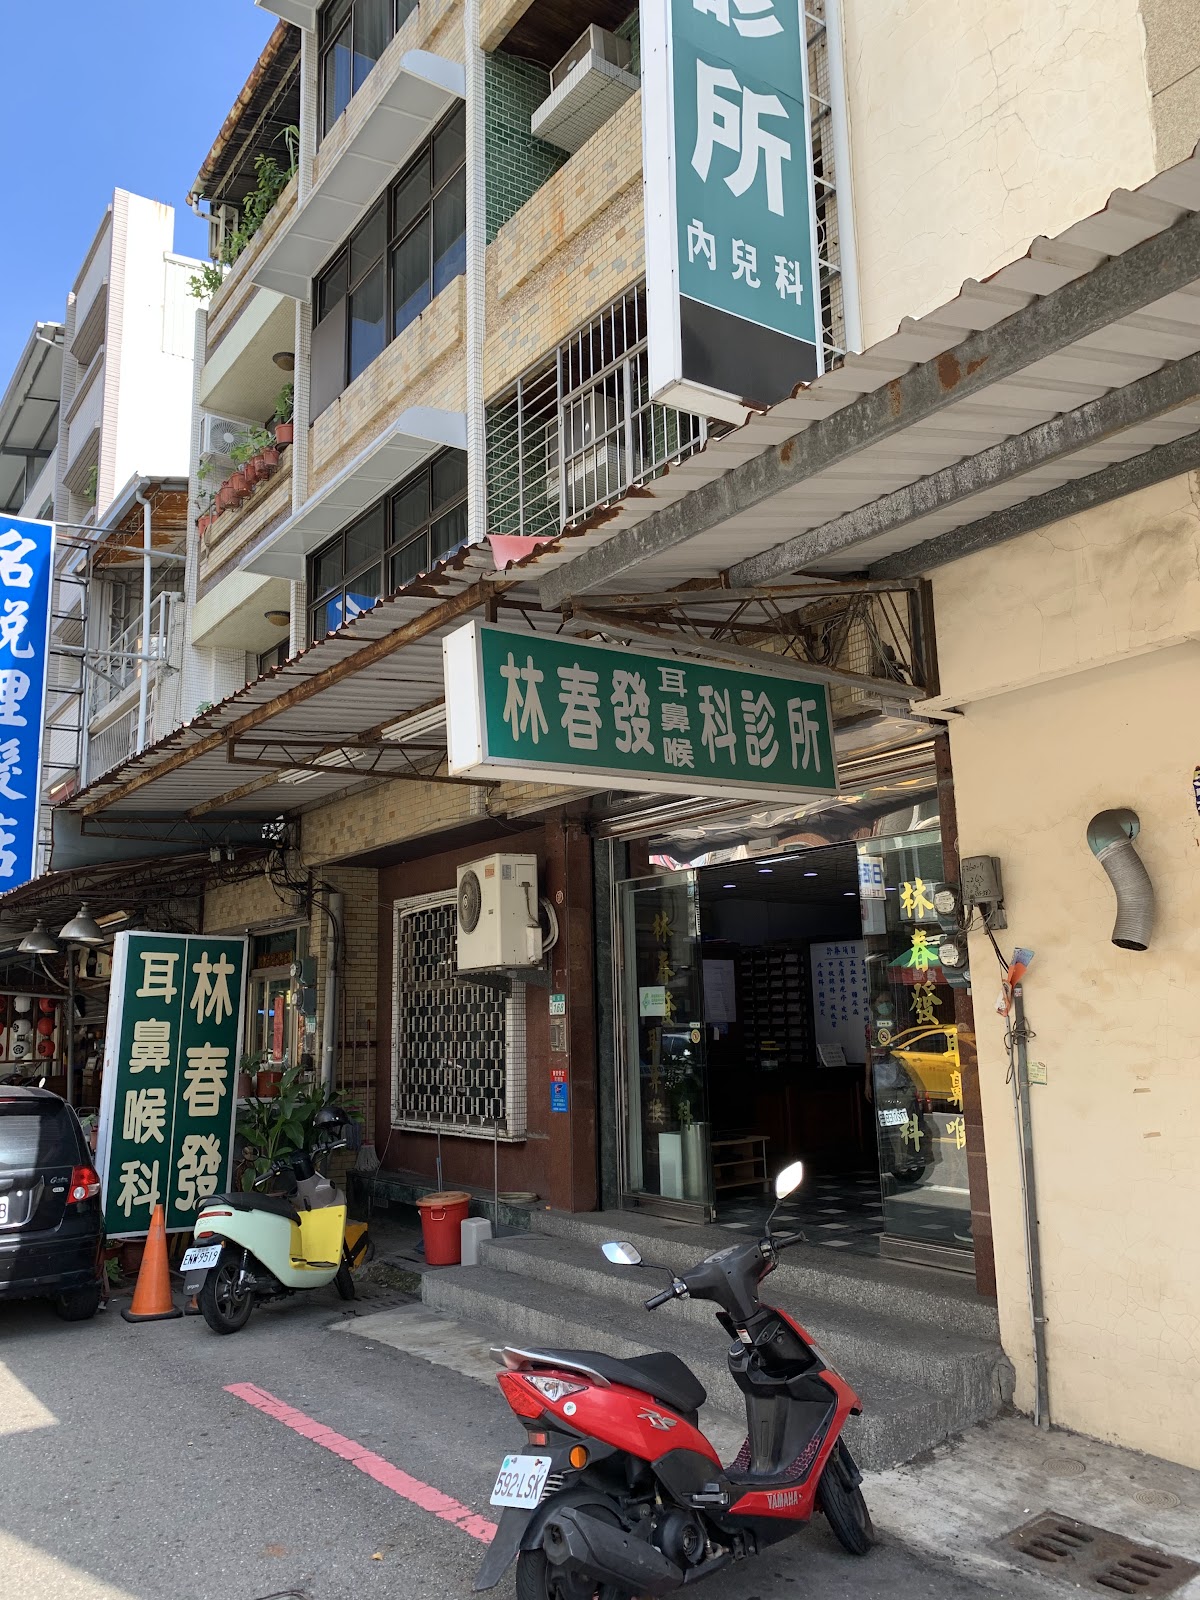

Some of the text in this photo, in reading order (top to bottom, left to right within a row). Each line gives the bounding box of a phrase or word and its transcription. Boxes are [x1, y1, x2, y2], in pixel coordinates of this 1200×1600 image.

[687, 218, 803, 306] 內兒科
[499, 651, 821, 773] 林春發 耳鼻喉 科診所
[900, 877, 943, 1026] 林春發
[553, 1002, 565, 1013] 168
[116, 951, 180, 1218] 耳鼻喉科
[174, 951, 235, 1212] 林春發
[900, 1113, 924, 1152] 科
[766, 1492, 799, 1509] YAMAHA
